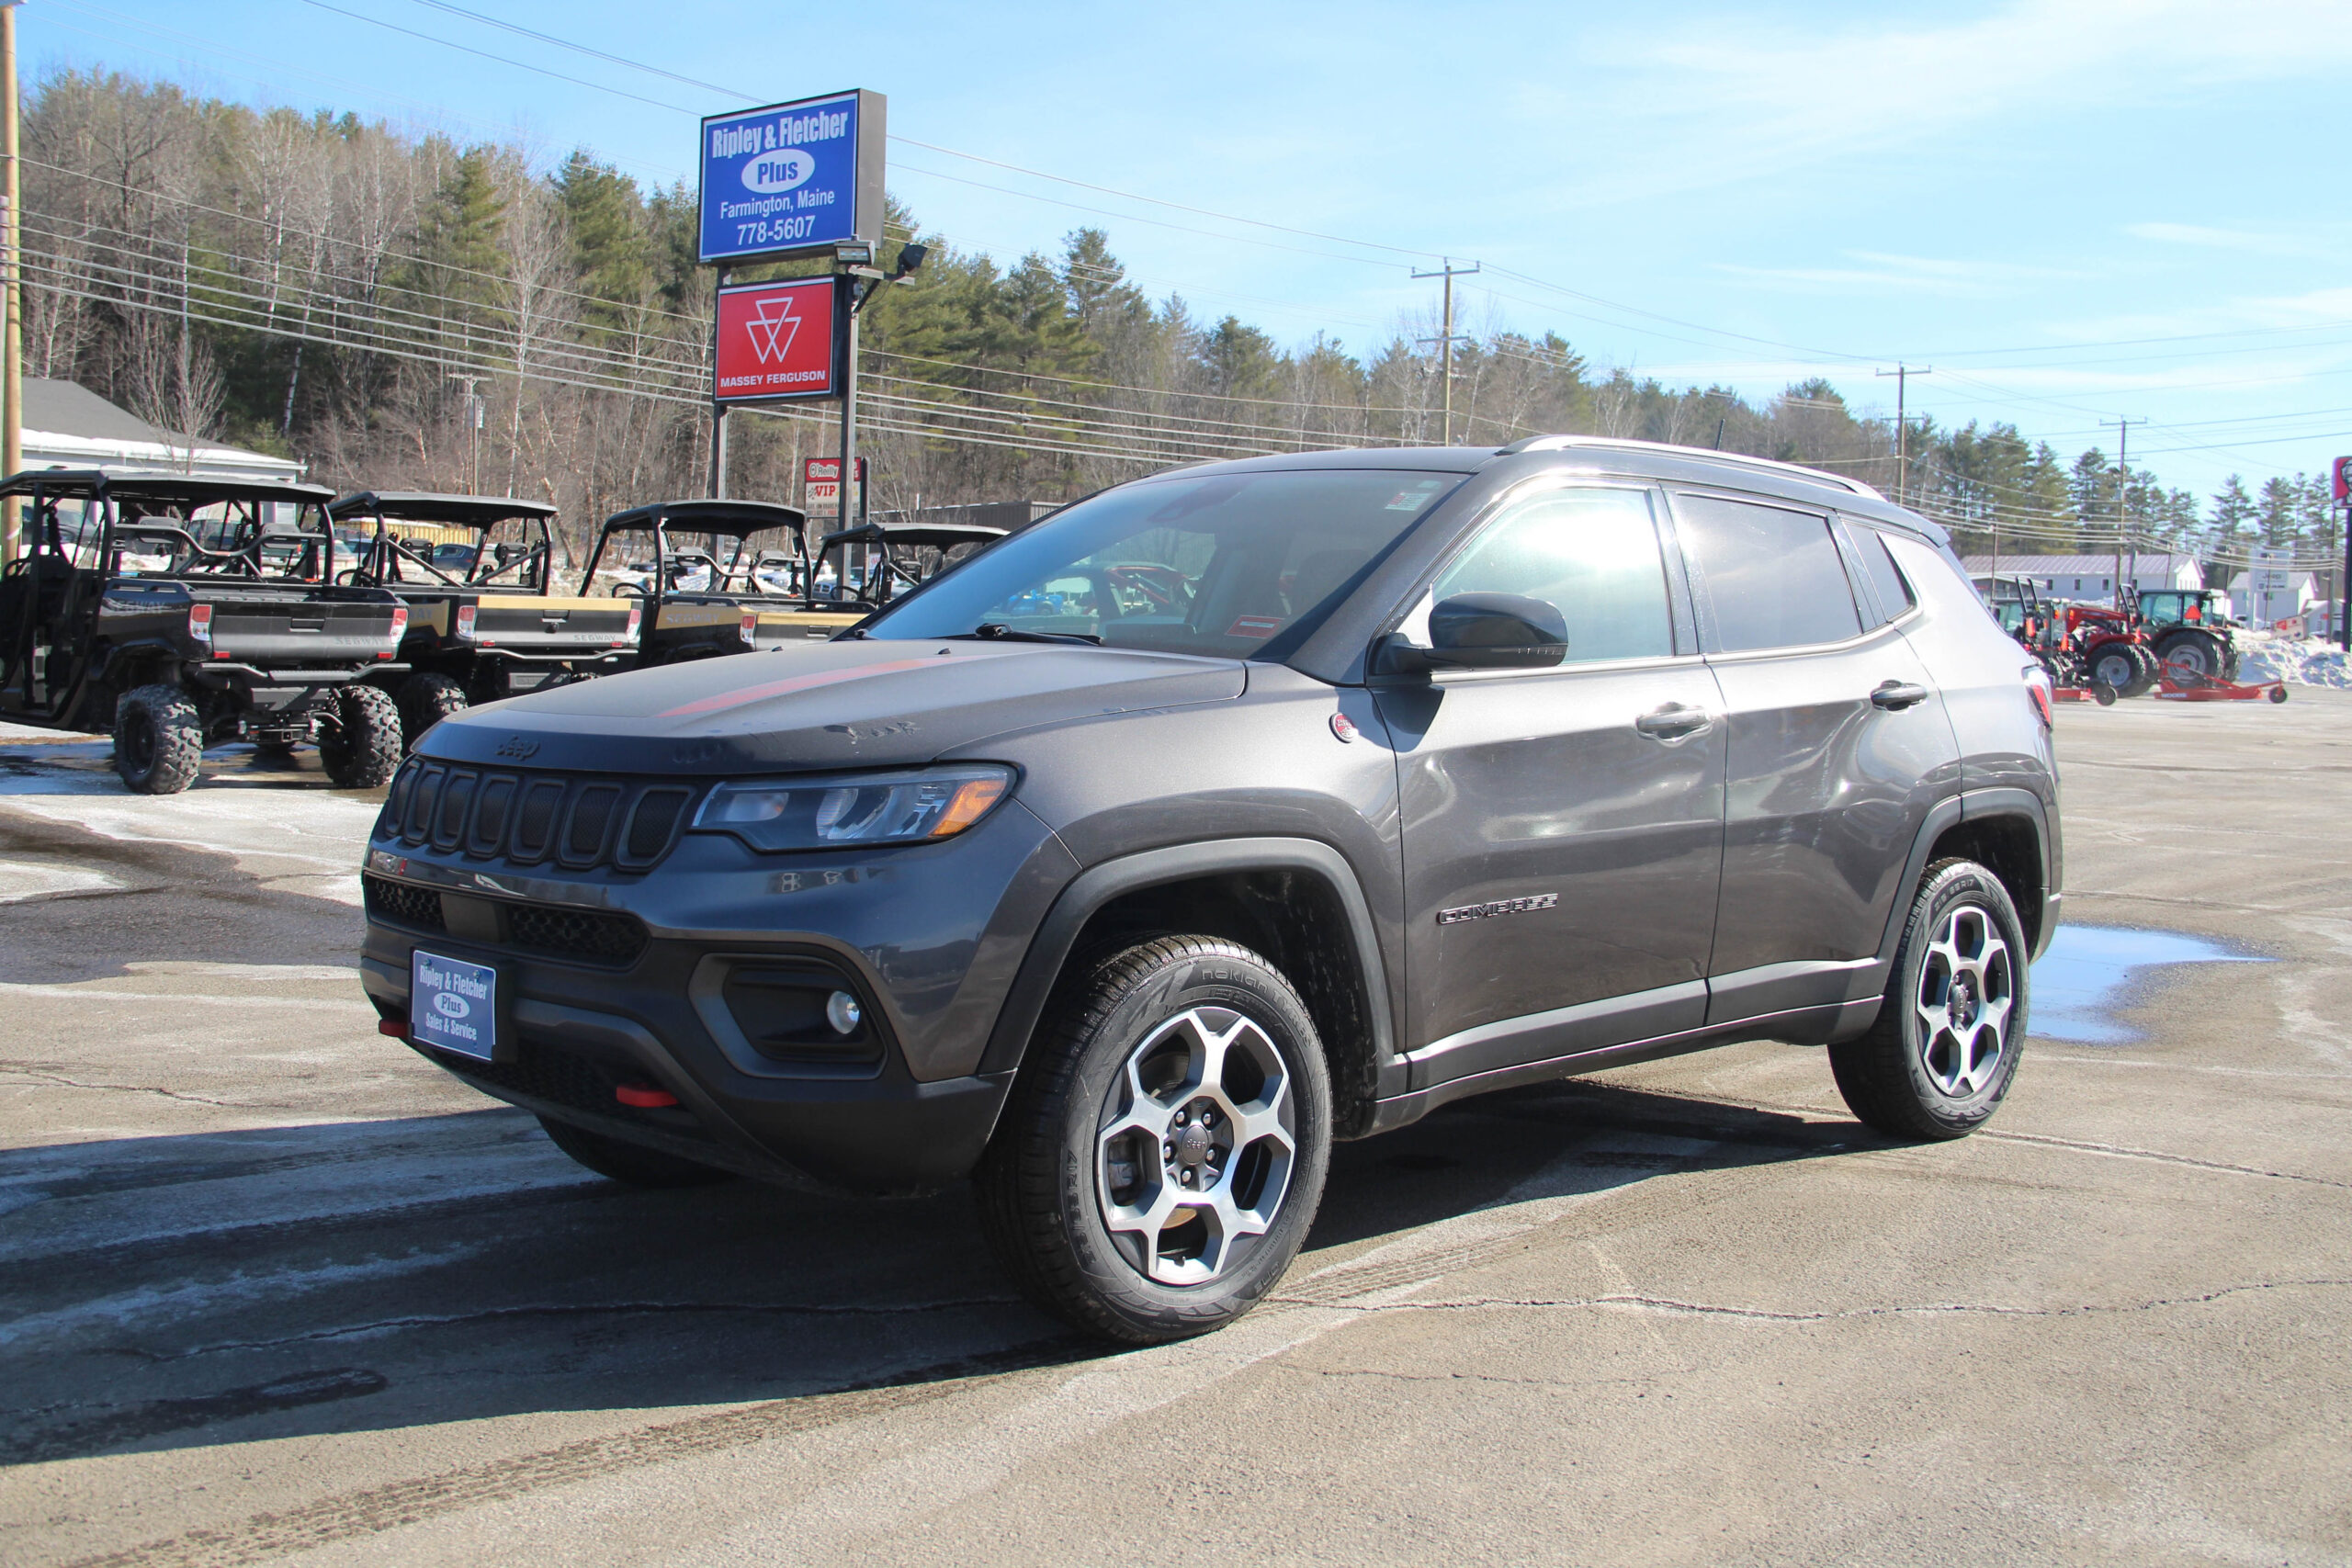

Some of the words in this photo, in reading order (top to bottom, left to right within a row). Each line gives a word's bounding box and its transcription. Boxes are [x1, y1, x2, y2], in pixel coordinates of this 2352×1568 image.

[712, 124, 762, 159] Ripley
[764, 125, 776, 149] &
[779, 111, 848, 147] Fletcher
[758, 162, 798, 185] Plus
[720, 196, 794, 220] Farmington,
[797, 188, 835, 209] Maine
[738, 215, 816, 245] 778-5607
[720, 375, 763, 388] MASSEY
[766, 370, 826, 384] FERGUSON
[809, 463, 839, 479] O'Reilly
[816, 485, 836, 497] VIP
[666, 613, 720, 624] SEGWAY
[573, 634, 616, 642] SEGWAY
[1437, 893, 1558, 924] COMPASS
[419, 964, 444, 990] Ripley
[445, 971, 452, 991] &
[453, 973, 488, 1000] Fletcher
[441, 995, 462, 1013] Plus
[1202, 968, 1268, 994] nokian
[1272, 990, 1313, 1048] TYRES
[425, 1011, 443, 1031] Sales
[444, 1018, 450, 1033] &
[450, 1019, 478, 1041] Service
